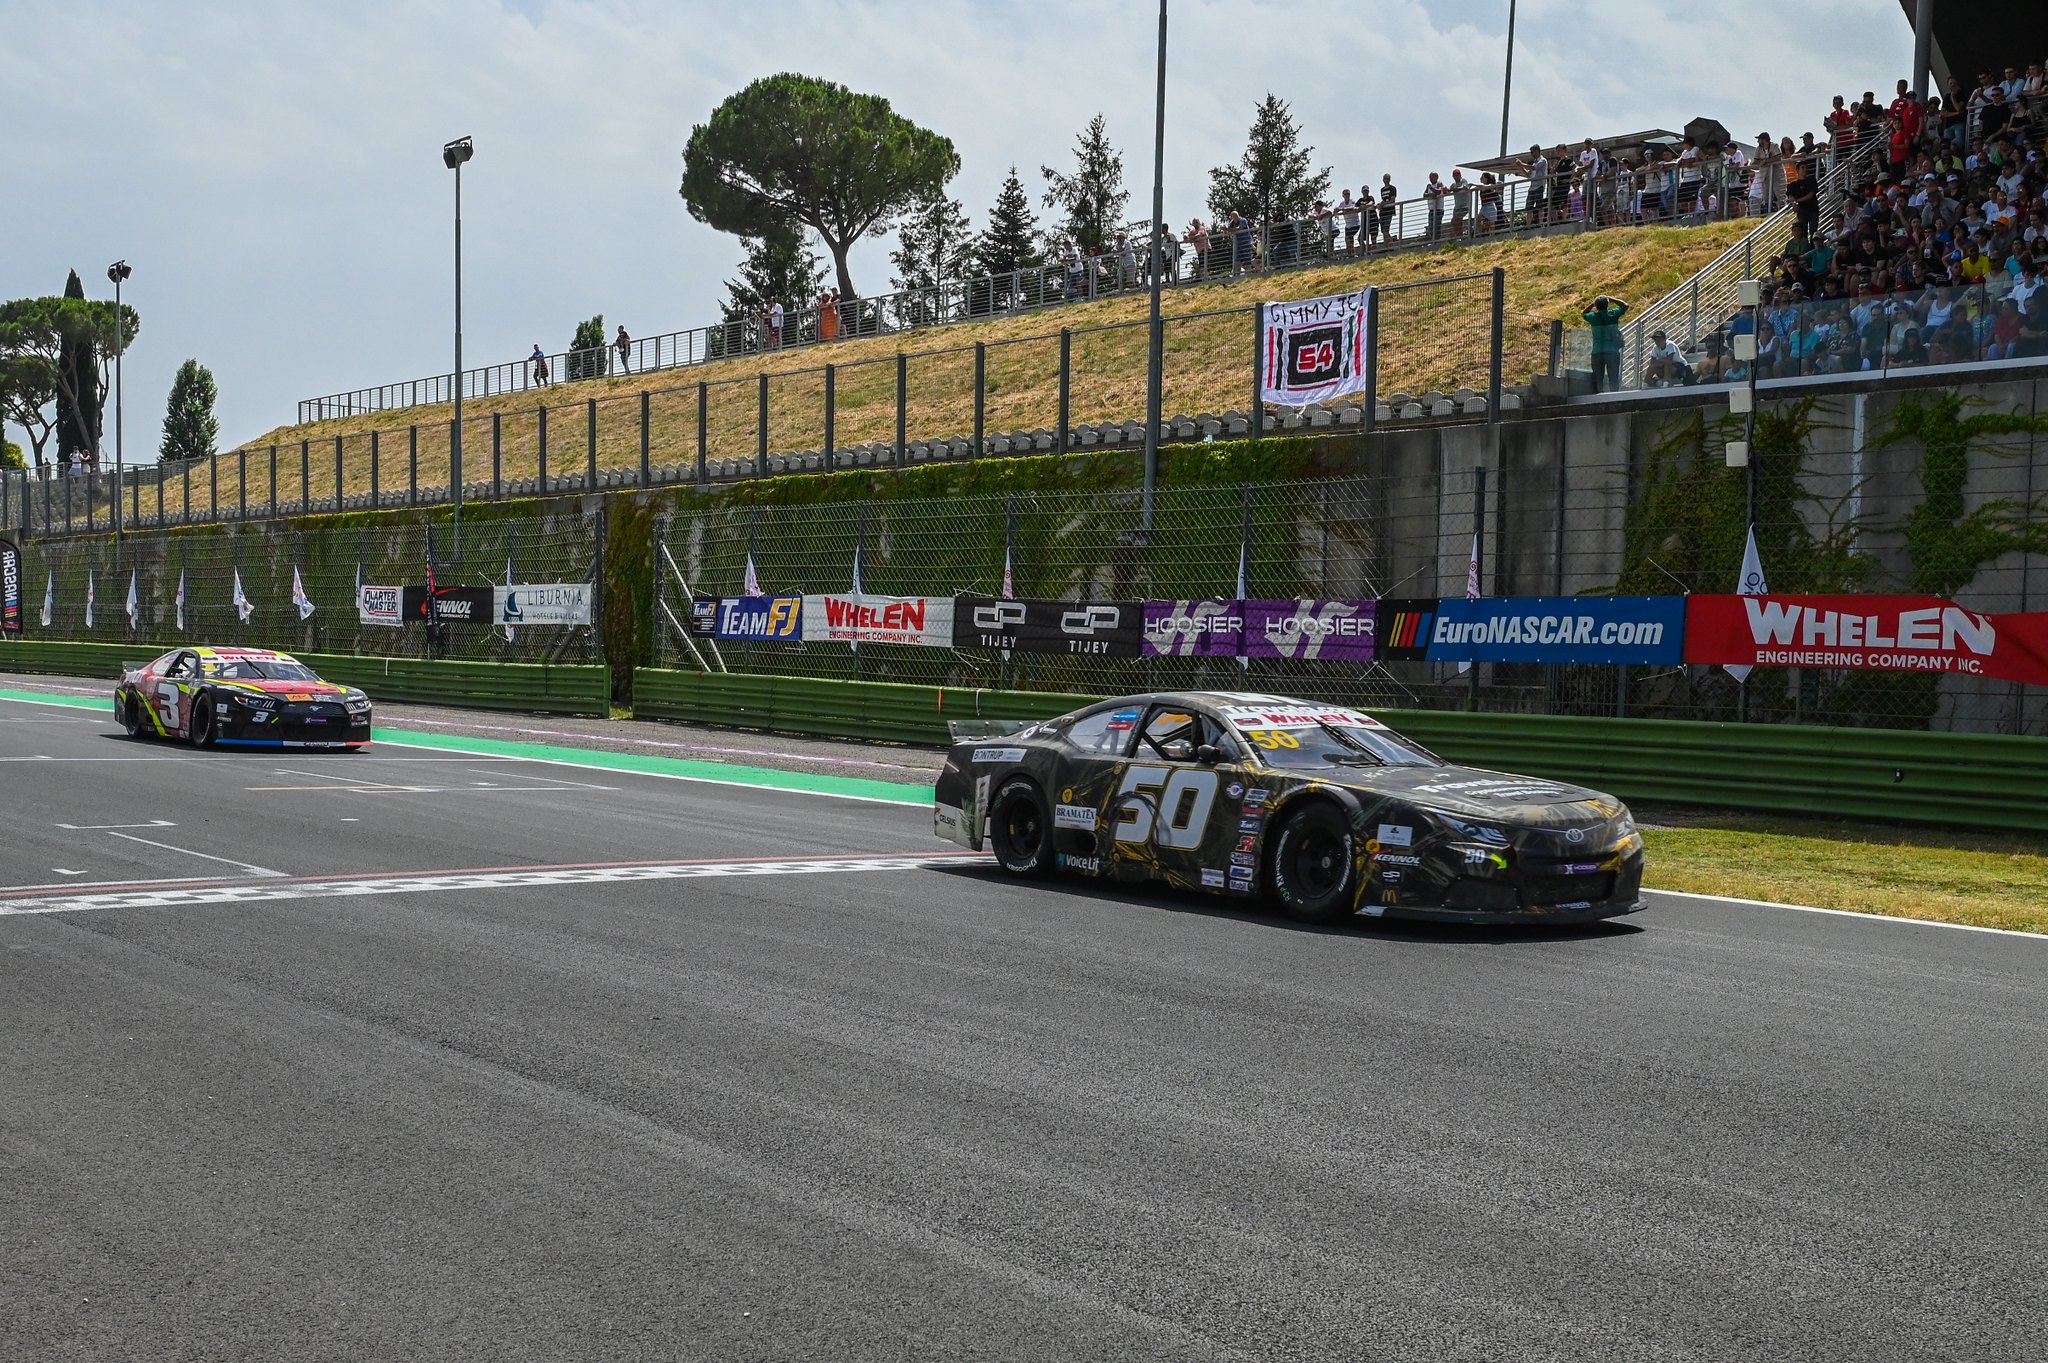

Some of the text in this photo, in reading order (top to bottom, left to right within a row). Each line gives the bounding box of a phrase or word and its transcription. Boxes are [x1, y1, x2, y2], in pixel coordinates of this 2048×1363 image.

[1296, 339, 1335, 373] 54
[364, 589, 396, 605] QUARTER
[527, 589, 583, 606] LIBURNIA
[368, 600, 397, 612] MASTER
[435, 600, 471, 614] ENNOL
[824, 596, 925, 632] WHELEN
[1144, 616, 1243, 633] HOOSIER
[1265, 616, 1375, 636] HOOSIER
[1433, 615, 1664, 645] EuroNASCAR.com
[1743, 597, 1997, 657] WHELEN
[829, 630, 923, 644] ENGINEERING COMPANY INC.
[980, 634, 1017, 648] TIJEY
[1069, 640, 1109, 654] TIJEY
[1756, 650, 1984, 674] ENGINEERING COMPANY INC.
[158, 682, 180, 729] 3
[252, 711, 269, 722] 3
[1247, 730, 1300, 750] 50
[1114, 765, 1220, 850] 50
[1374, 853, 1421, 864] KENNOL
[1464, 848, 1486, 864] 50
